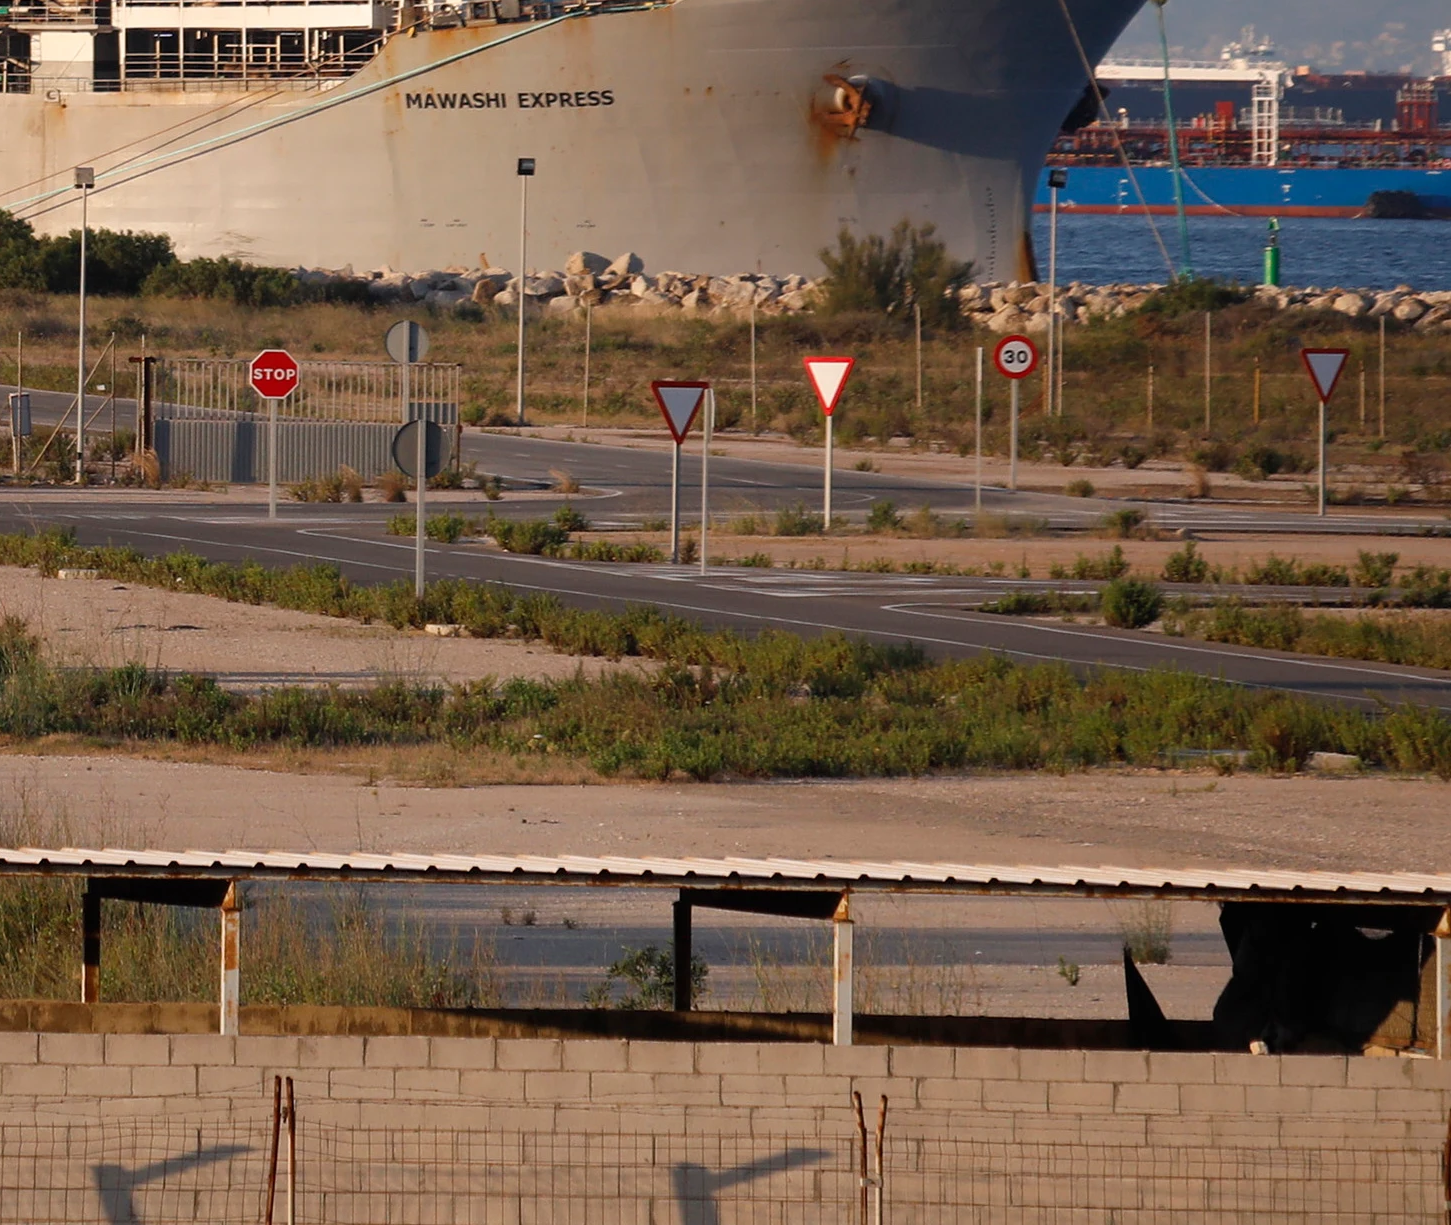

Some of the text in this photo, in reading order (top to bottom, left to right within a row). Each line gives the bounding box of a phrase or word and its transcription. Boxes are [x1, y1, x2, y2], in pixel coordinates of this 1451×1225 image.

[405, 90, 615, 109] MAWASHI EXPRESS
[1003, 349, 1028, 364] 30
[253, 368, 296, 381] STOP
